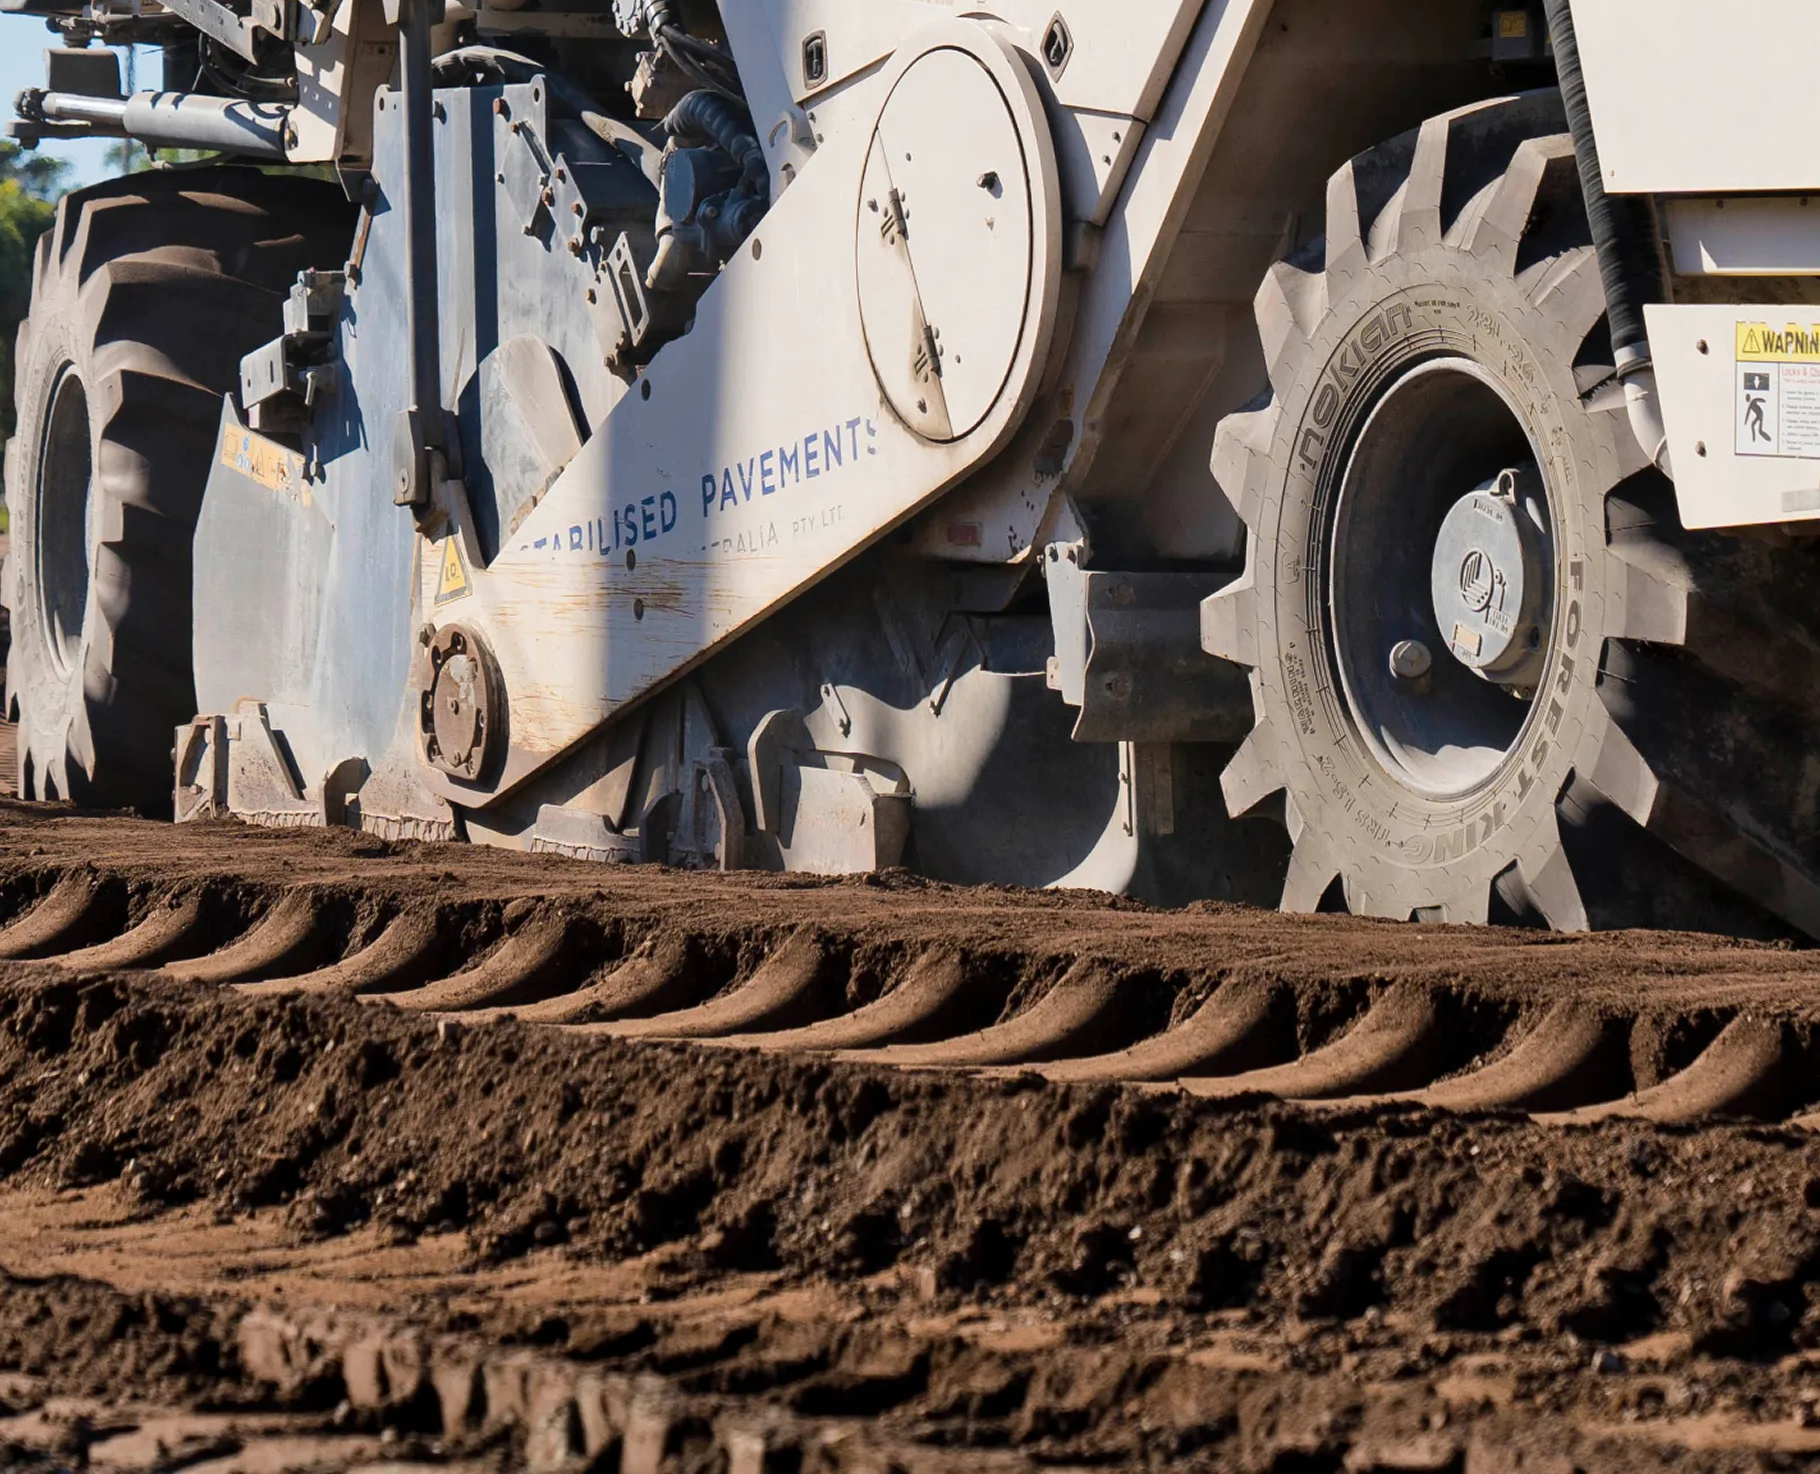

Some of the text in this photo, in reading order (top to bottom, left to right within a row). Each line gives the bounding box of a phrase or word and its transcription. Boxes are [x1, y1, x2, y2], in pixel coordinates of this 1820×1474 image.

[520, 491, 677, 555] BILISED
[1516, 560, 1584, 804] FOREST
[1402, 801, 1506, 864] KING
